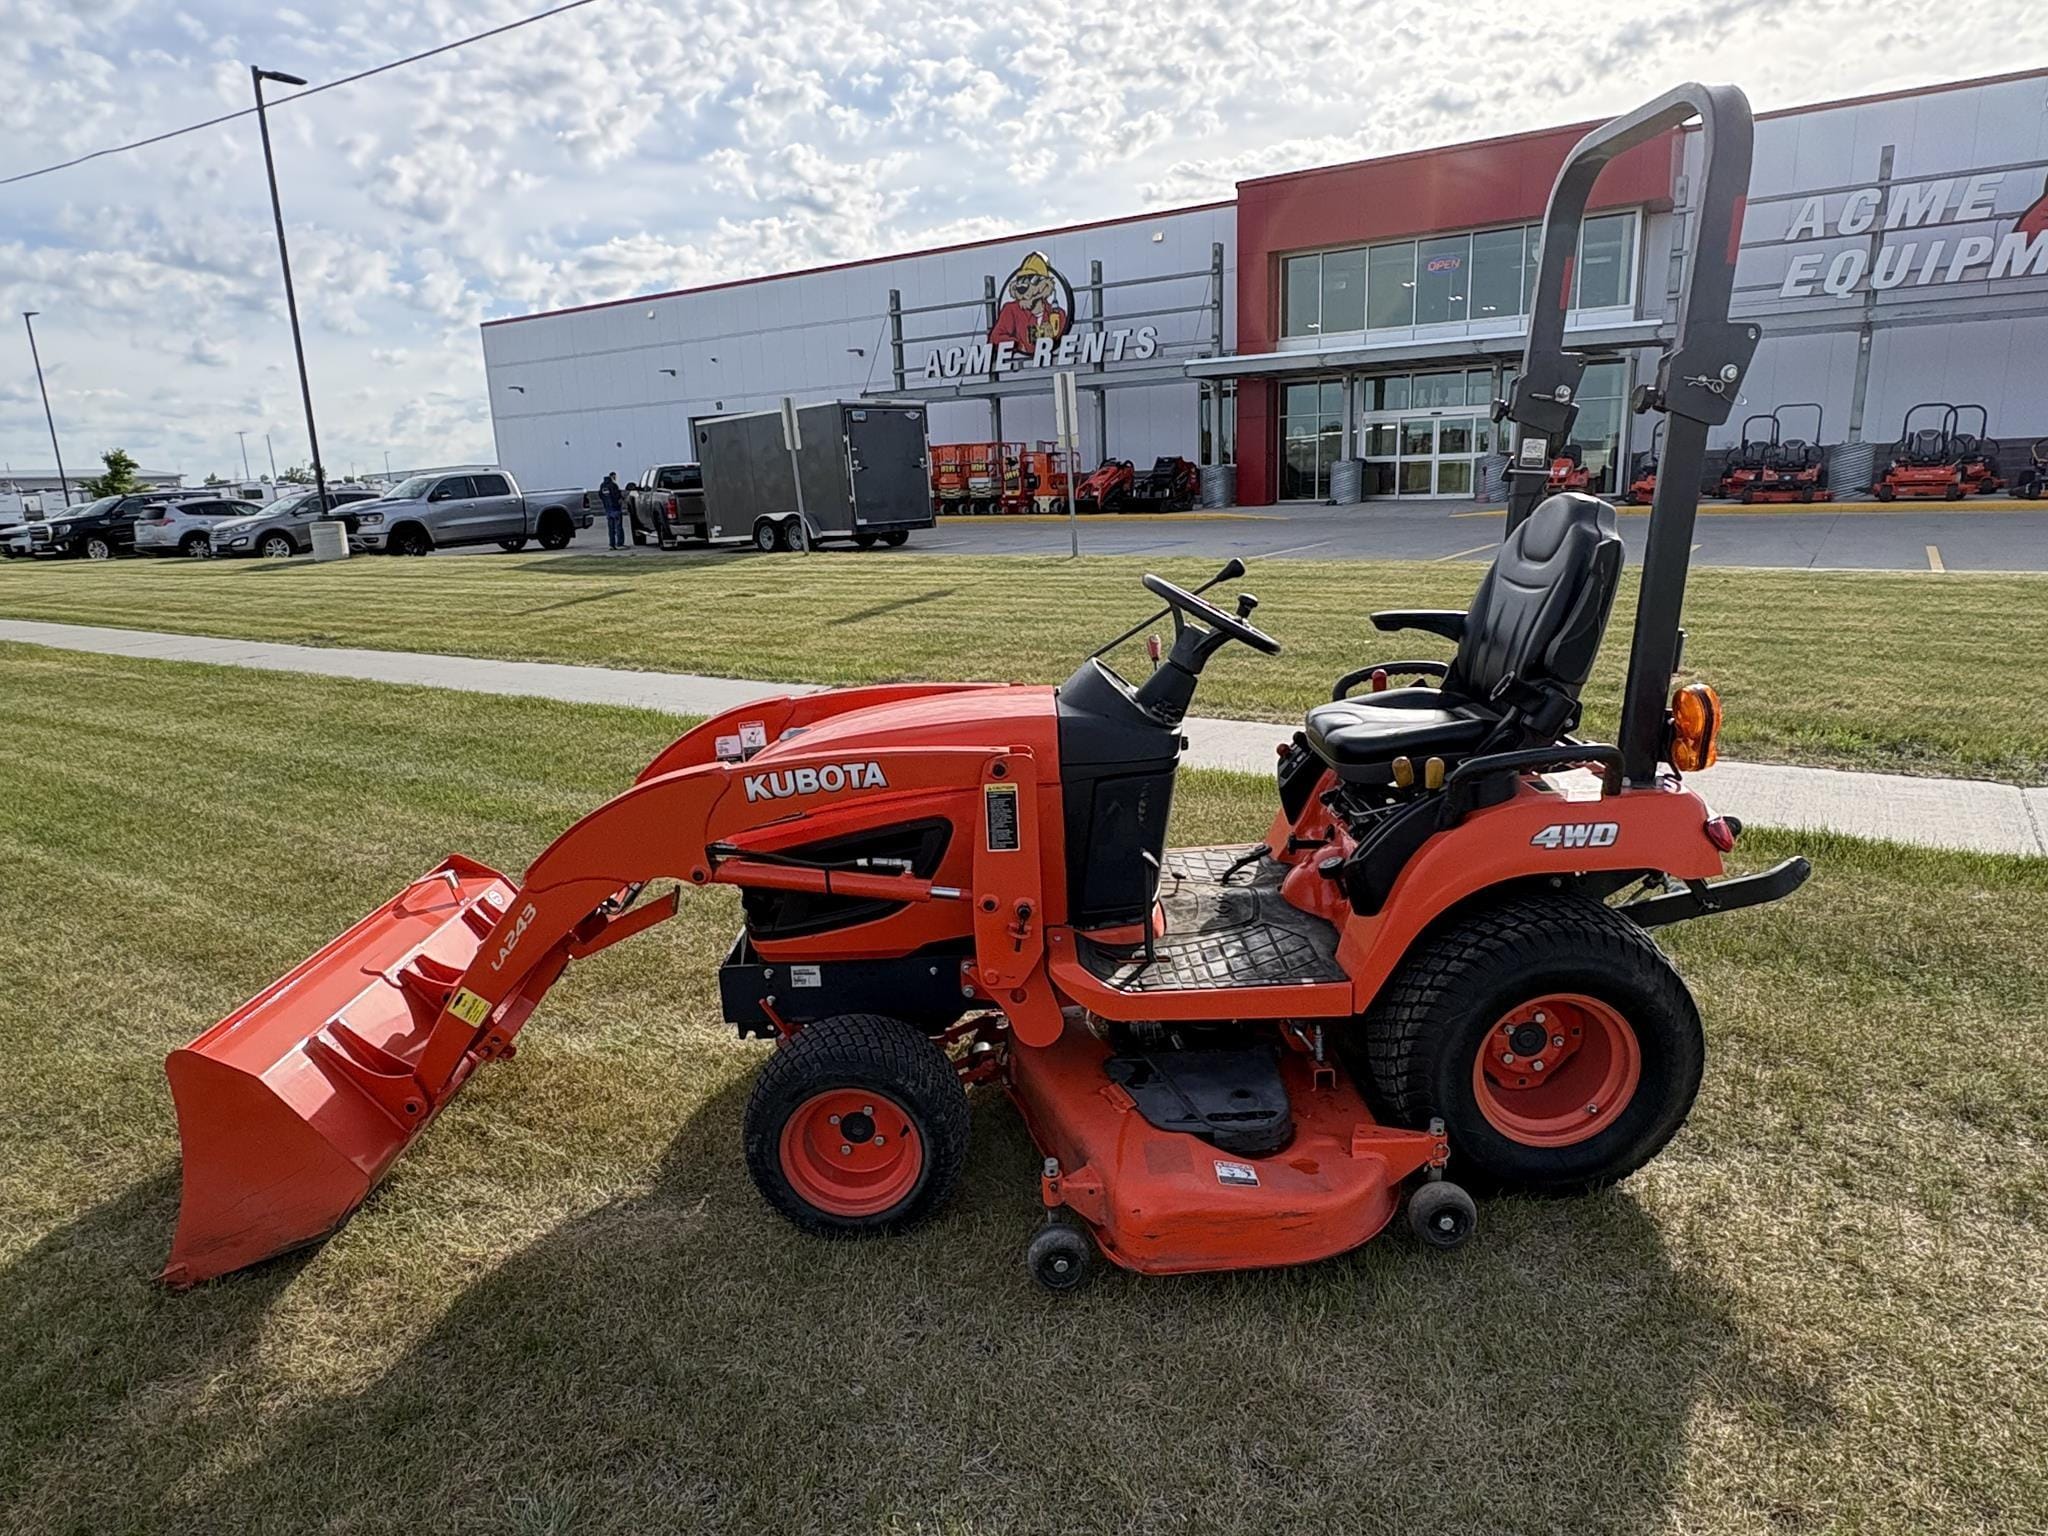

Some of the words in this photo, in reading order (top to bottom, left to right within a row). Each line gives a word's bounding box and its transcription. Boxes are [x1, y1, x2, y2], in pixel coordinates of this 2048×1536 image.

[1785, 173, 2006, 241] ACME
[1427, 258, 1461, 271] OPEN
[924, 341, 1015, 379] ACME
[1033, 327, 1157, 368] RENTS
[743, 761, 889, 802] KUBOTA
[1530, 822, 1620, 849] 4WD
[491, 902, 537, 971] LA243
